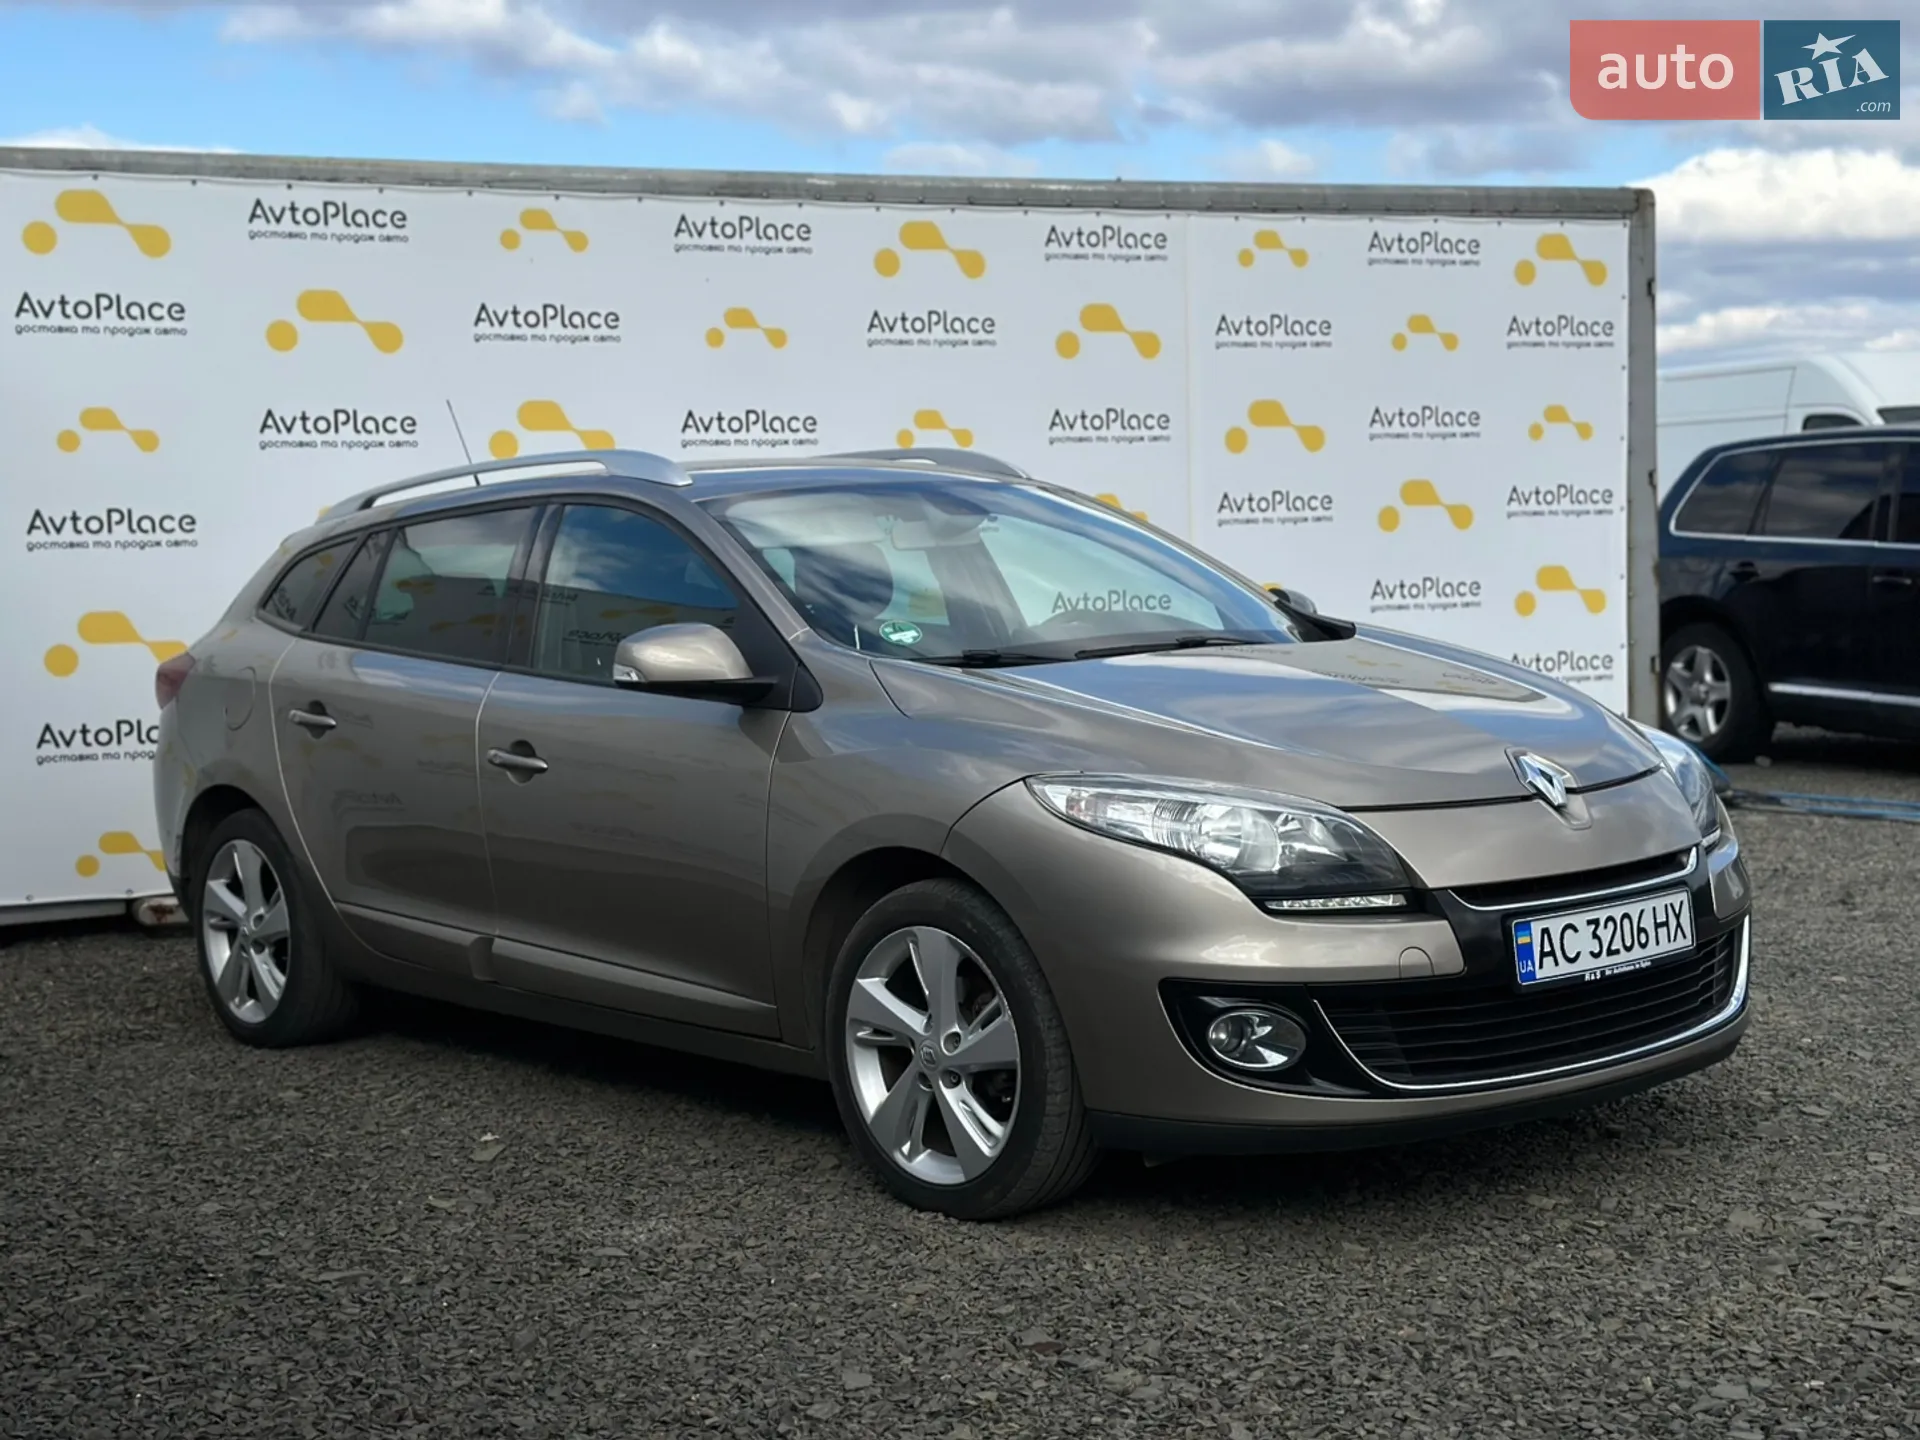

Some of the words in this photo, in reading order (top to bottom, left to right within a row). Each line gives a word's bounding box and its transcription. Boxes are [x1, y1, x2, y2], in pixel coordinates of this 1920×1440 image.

[248, 197, 407, 229] AvtoPlace
[674, 214, 812, 242] AvtoPlace
[1045, 224, 1167, 250] AvtoPlace
[1368, 230, 1480, 256] AvtoPlace
[15, 291, 186, 322] AvtoPlace
[474, 302, 620, 330] AvtoPlace
[15, 324, 78, 336] доставка
[81, 325, 100, 334] та
[103, 326, 151, 338] продаж
[154, 327, 188, 336] авто
[867, 310, 995, 334] AvtoPlace
[1216, 314, 1331, 336] AvtoPlace
[1507, 315, 1614, 337] AvtoPlace
[259, 408, 417, 435] AvtoPlace
[681, 409, 817, 434] AvtoPlace
[1049, 408, 1170, 431] AvtoPlace
[1369, 406, 1480, 427] AvtoPlace
[259, 440, 318, 451] доставка
[320, 440, 338, 448] та
[341, 440, 385, 450] продаж
[388, 440, 418, 448] авто
[1218, 489, 1333, 514] AvtoPlace
[1507, 483, 1613, 507] AvtoPlace
[26, 507, 196, 536] AvtoPlace
[26, 540, 90, 553] доставка
[92, 540, 112, 550] та
[114, 539, 162, 551] продаж
[165, 539, 198, 549] авто
[1371, 576, 1481, 600] AvtoPlace
[1052, 590, 1172, 613] AvtoPlace
[35, 752, 99, 766] доставка
[102, 751, 121, 761] та
[1538, 923, 1582, 970] AC
[1586, 909, 1649, 959] 3206
[1652, 900, 1687, 946] HX
[1519, 959, 1535, 973] UA
